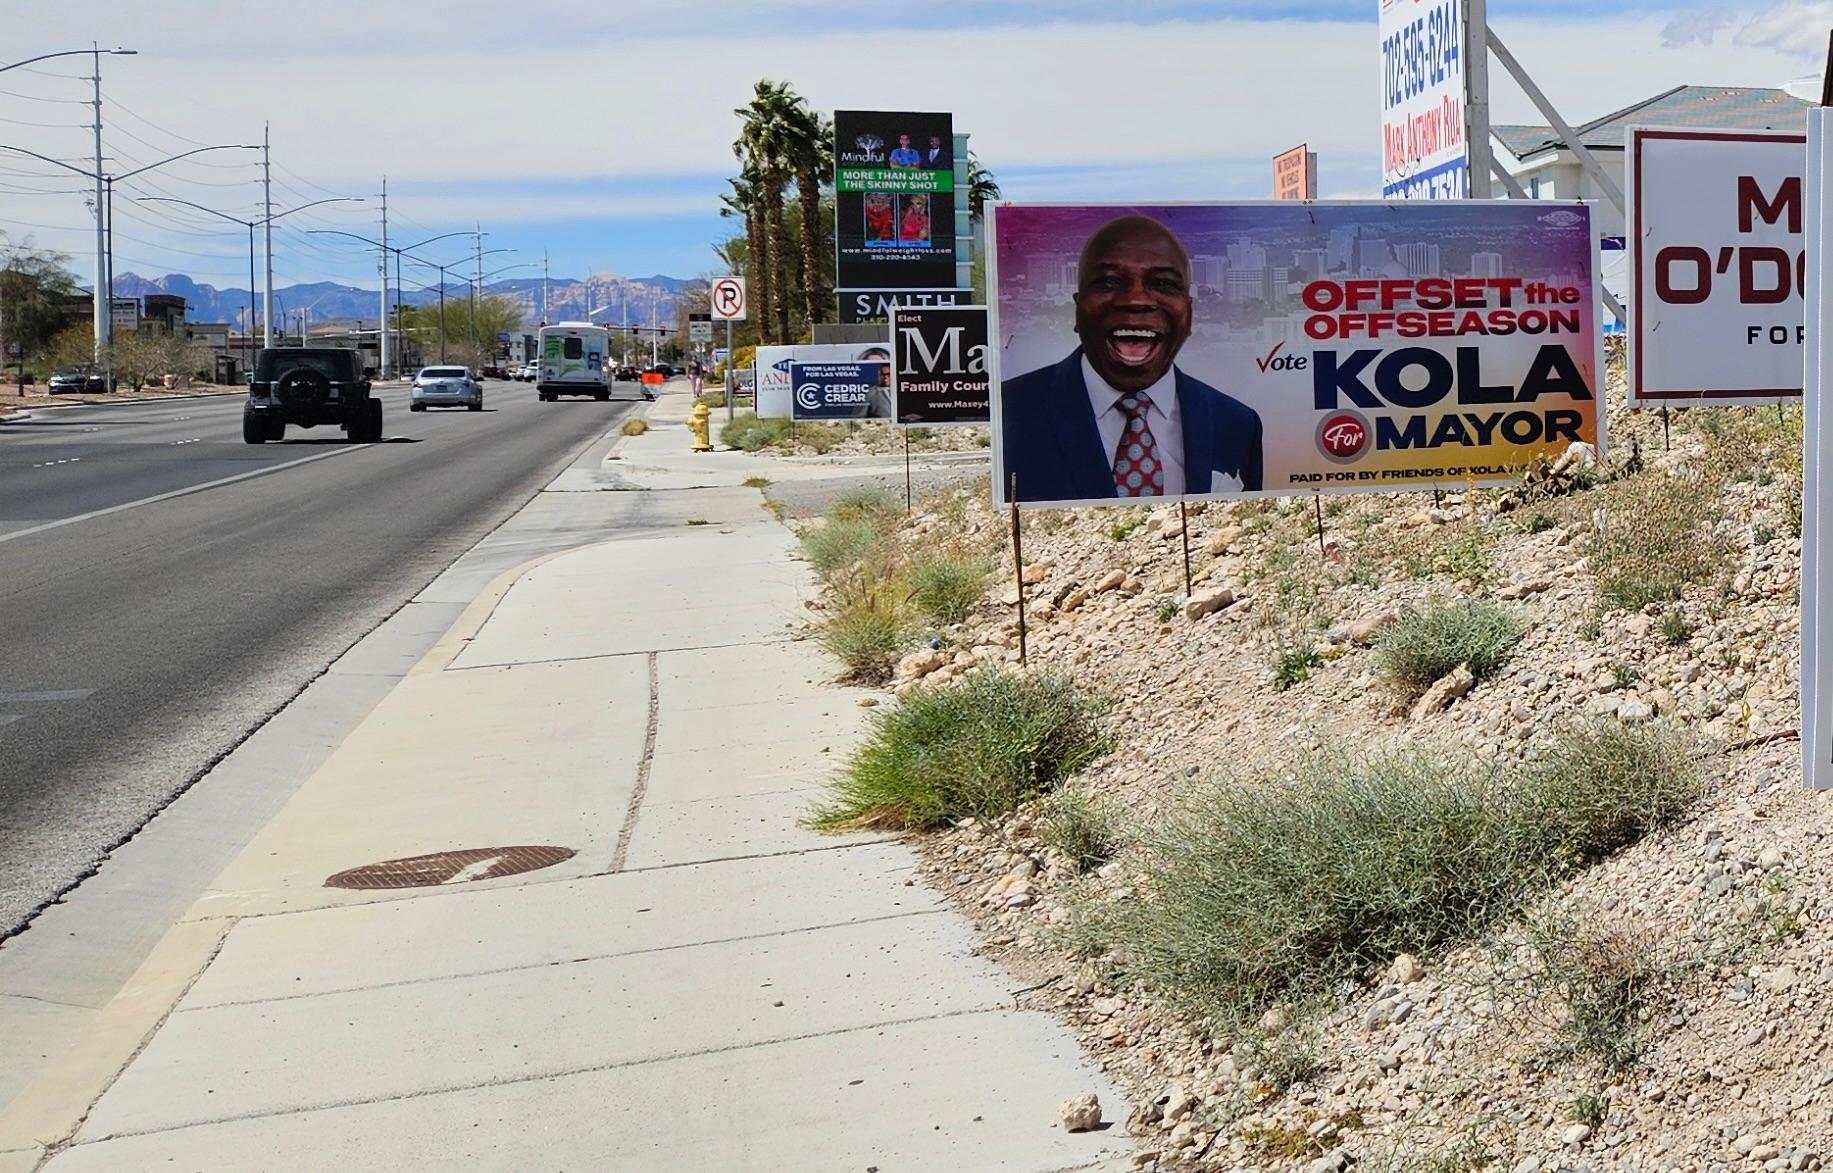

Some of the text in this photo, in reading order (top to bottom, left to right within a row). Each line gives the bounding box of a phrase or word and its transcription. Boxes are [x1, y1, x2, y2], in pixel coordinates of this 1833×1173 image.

[1383, 0, 1459, 111] 702-595-6244
[841, 151, 885, 162] Mindful
[843, 171, 936, 180] MORE THAN JUST
[844, 180, 938, 190] THE SKINNY SHOT
[1655, 246, 1805, 305] O'D
[1302, 278, 1581, 312] OFFSET the
[897, 314, 922, 323] Elect
[1303, 309, 1580, 340] OFFSEASON
[1312, 344, 1594, 410] KOLA
[824, 384, 870, 394] CEDRIC
[900, 380, 949, 393] Family
[824, 393, 866, 403] CREAR
[1324, 409, 1585, 451] For MAYOR
[1289, 473, 1323, 483] PAID
[1325, 471, 1357, 482] FOR
[1359, 470, 1379, 481] BY
[1382, 467, 1445, 480] FRIENDS
[1446, 467, 1468, 477] OF
